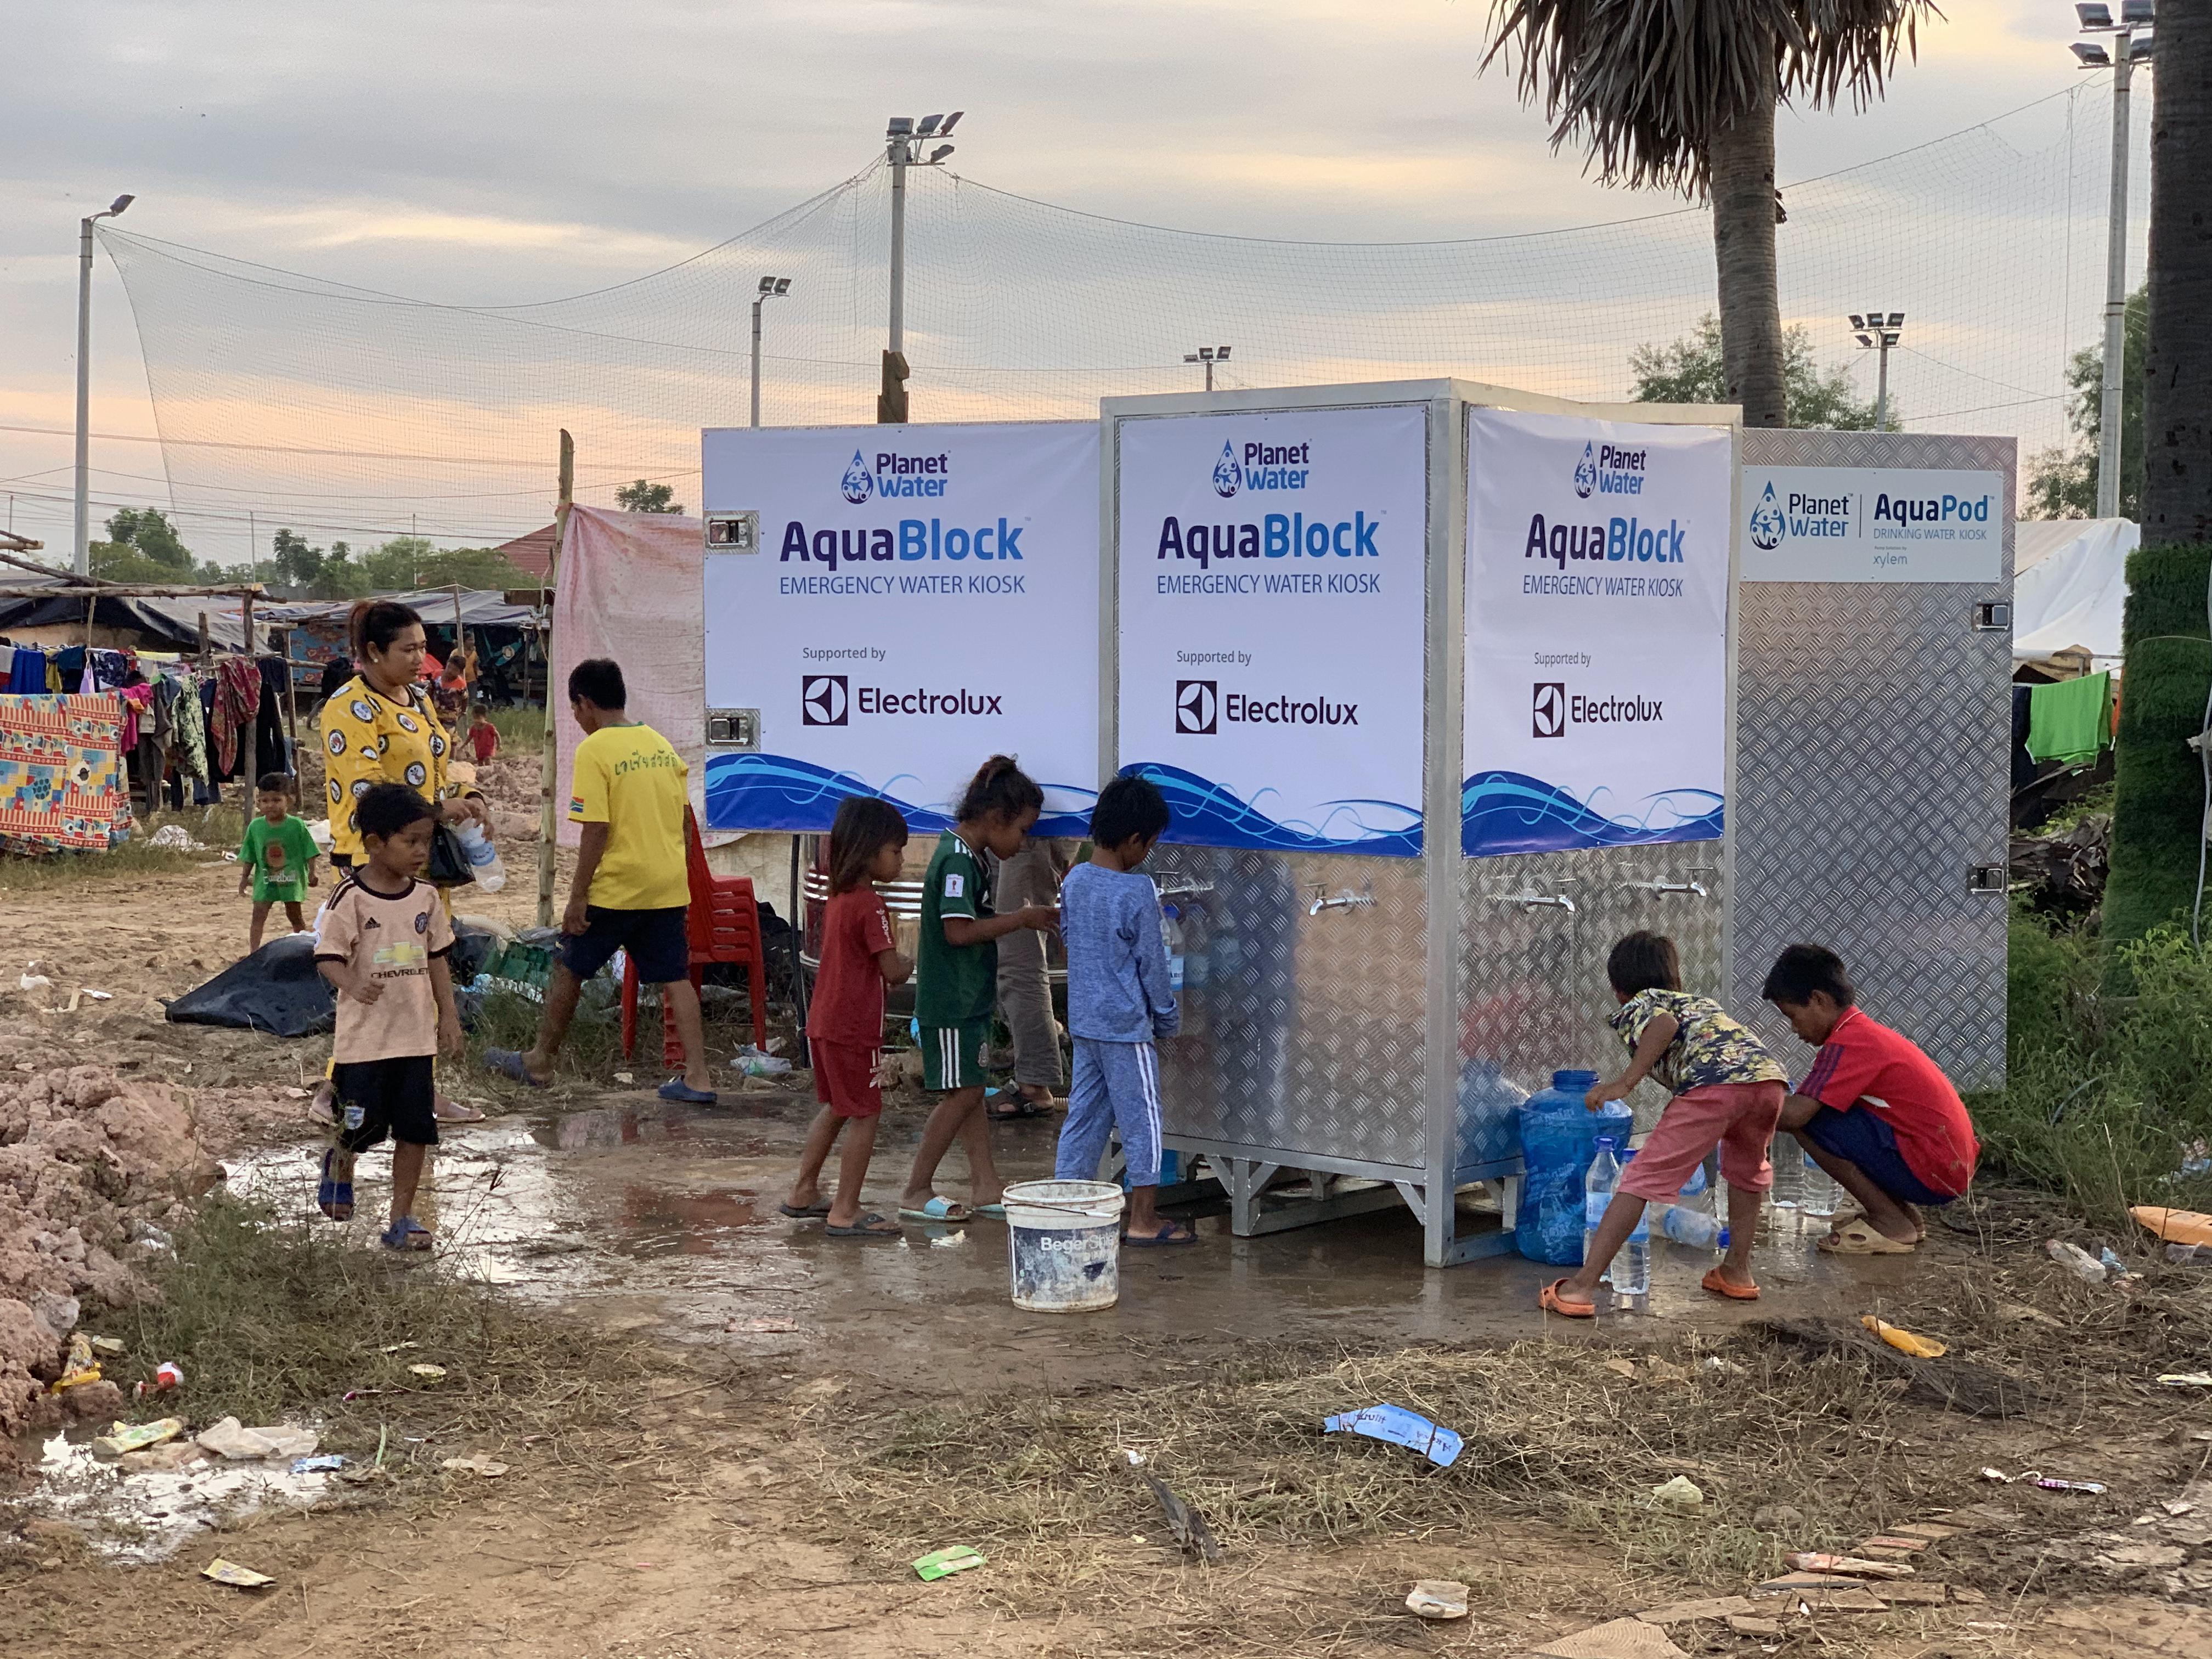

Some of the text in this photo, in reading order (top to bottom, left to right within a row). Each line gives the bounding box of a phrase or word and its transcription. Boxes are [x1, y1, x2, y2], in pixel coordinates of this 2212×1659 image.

[877, 453, 947, 474] Planet
[1245, 443, 1309, 465] Planet
[1600, 445, 1646, 470] Planet
[877, 476, 947, 497] Water
[1245, 467, 1309, 490] Water
[1599, 470, 1644, 494] Water
[1790, 494, 1849, 515] Planet
[1874, 494, 1987, 527] AquaPod
[1790, 516, 1849, 537] Water
[1874, 528, 1987, 540] DRINKING WATER KIOSK
[780, 518, 1023, 571] AquaBlock
[1158, 511, 1379, 569] AquaBlock
[1525, 514, 1685, 569] AquaBlock
[1873, 552, 1907, 568] xylem
[781, 575, 1025, 594] EMERGENCY WATER KIOSK
[1158, 574, 1380, 593] EMERGENCY WATER KIOSK
[1523, 575, 1683, 596] EMERGENCY WATER KIOSK
[803, 647, 885, 662] Supported by
[1177, 651, 1251, 666] Supported by
[1534, 652, 1591, 667] Supported by
[859, 688, 1002, 714] Electrolux
[1227, 695, 1358, 725] Electrolux
[1572, 695, 1662, 723] Electrolux
